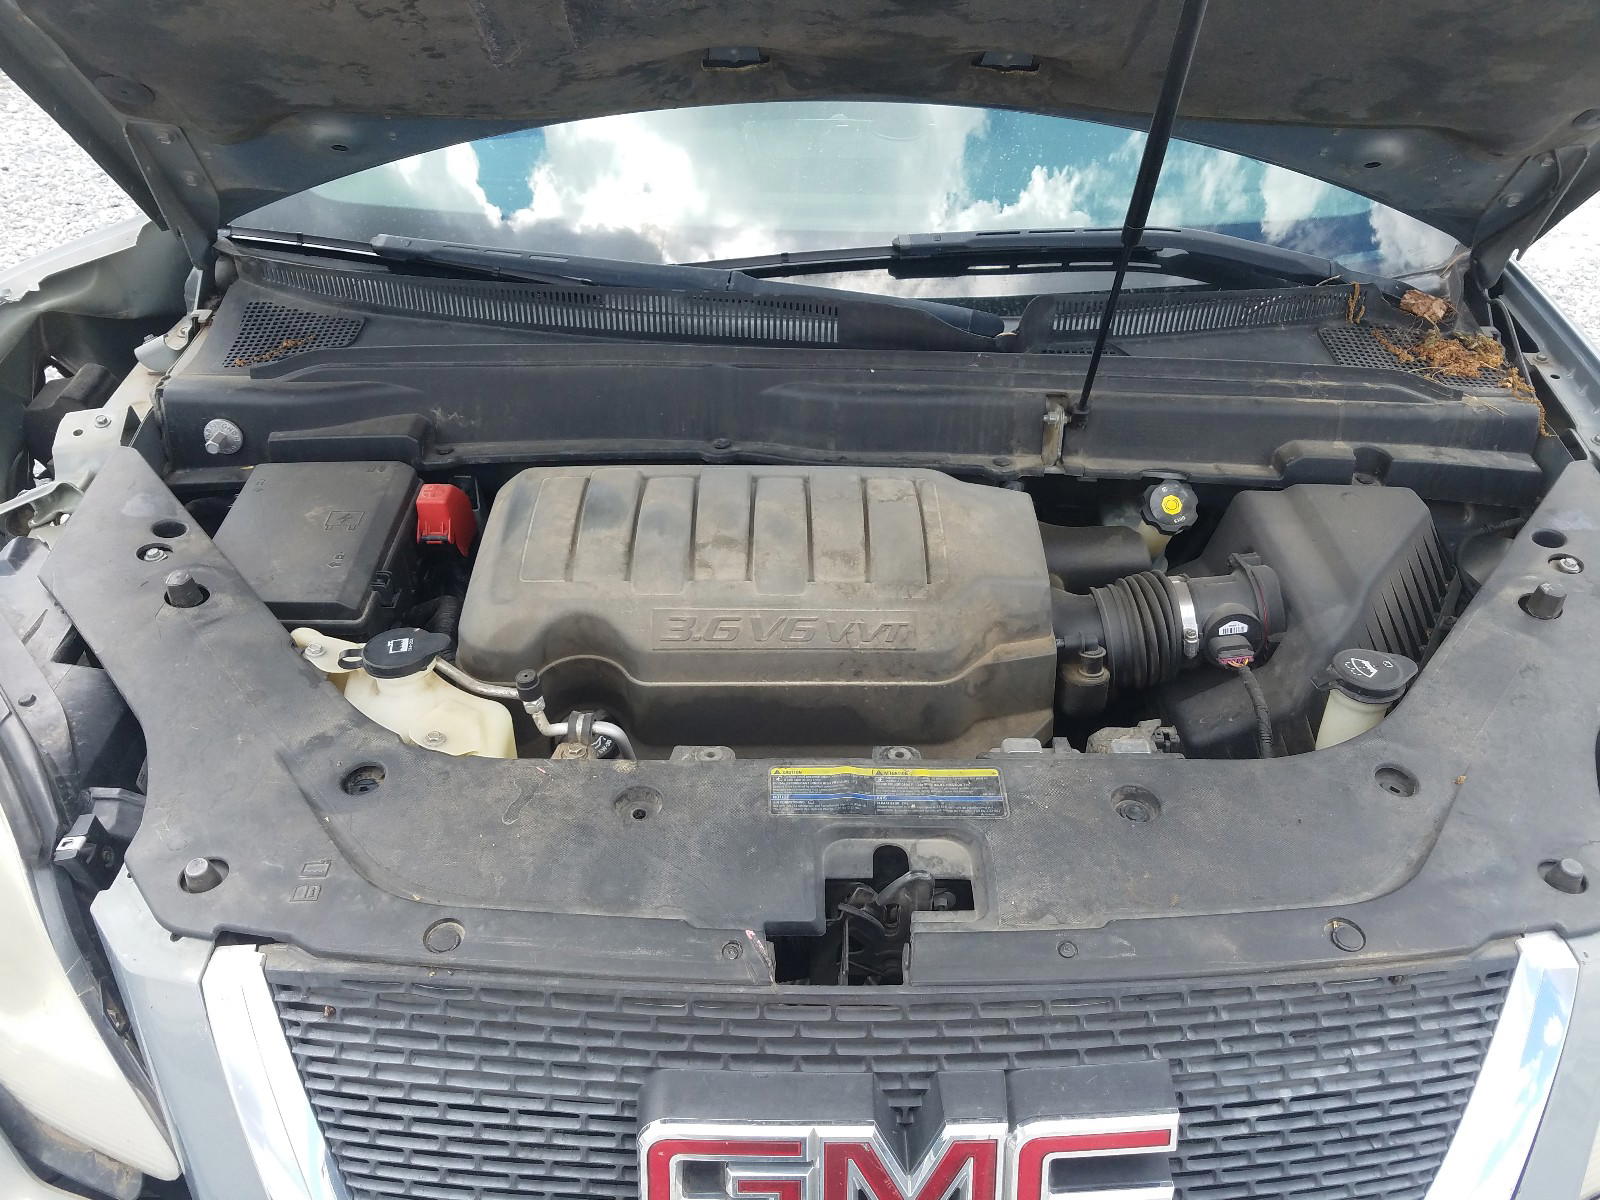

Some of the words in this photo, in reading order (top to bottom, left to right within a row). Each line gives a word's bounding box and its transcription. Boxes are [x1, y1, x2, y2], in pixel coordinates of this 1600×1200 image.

[659, 616, 741, 643] 3.6
[751, 616, 819, 643] V6
[825, 621, 910, 644] VVT
[637, 1111, 1180, 1200] GMC
